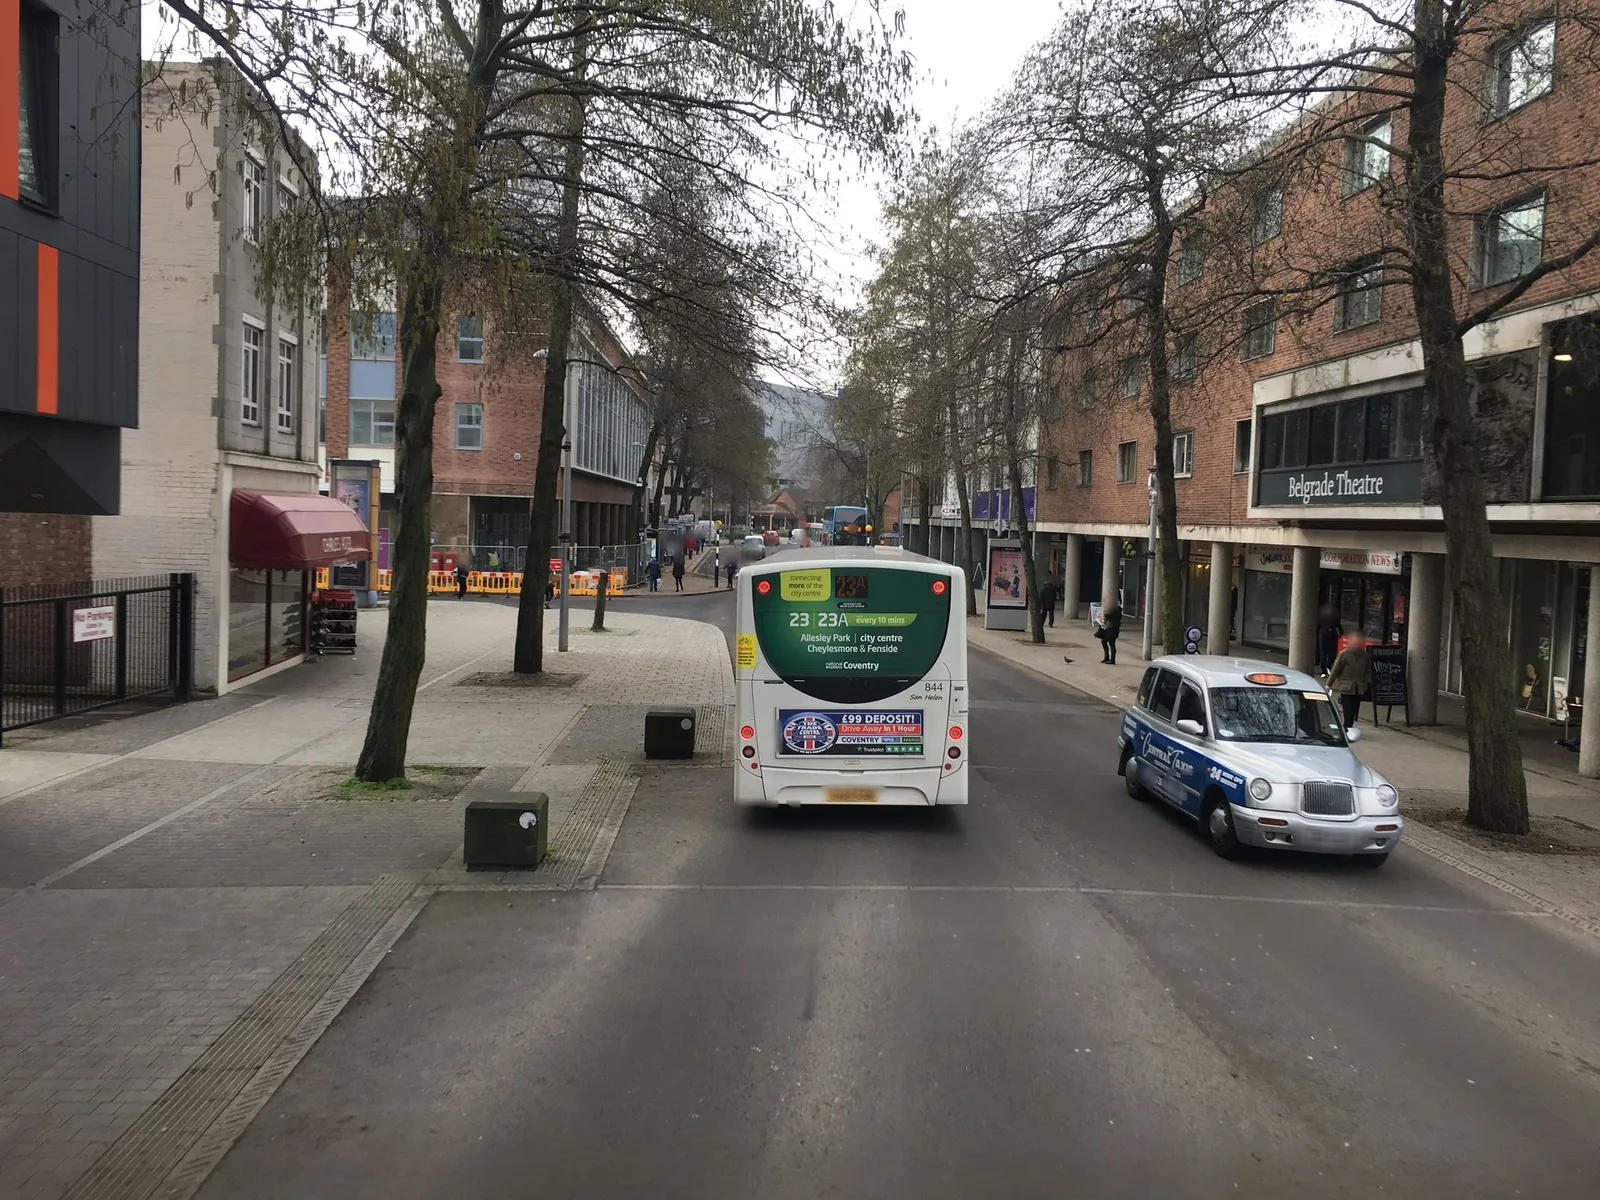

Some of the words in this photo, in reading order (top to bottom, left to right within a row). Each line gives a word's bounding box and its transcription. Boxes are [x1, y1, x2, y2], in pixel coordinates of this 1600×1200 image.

[1288, 472, 1334, 504] Belgrade
[1336, 470, 1383, 495] Theatre
[1324, 551, 1370, 565] CORPORATION
[1371, 554, 1391, 567] NEWS
[790, 590, 801, 598] city
[73, 613, 85, 623] No
[87, 611, 113, 621] Parking
[789, 613, 810, 627] 23
[818, 613, 849, 627] 23A
[856, 616, 877, 626] every
[878, 616, 887, 624] 10
[887, 616, 906, 624] mins
[800, 633, 832, 644] Allesley
[833, 633, 851, 642] Park
[860, 633, 876, 644] city
[877, 634, 903, 643] centre
[807, 644, 858, 655] Cheylesmore
[859, 645, 866, 653] &
[867, 644, 898, 653] Fenside
[843, 661, 880, 671] Coventry
[924, 682, 943, 692] 844
[909, 693, 923, 701] San
[841, 714, 861, 724] £99
[865, 714, 915, 724] DEPOSIT!
[841, 724, 861, 732] Drive
[862, 724, 882, 733] Away
[883, 724, 891, 732] In
[898, 724, 916, 732] Hour
[1210, 767, 1222, 781] 24
